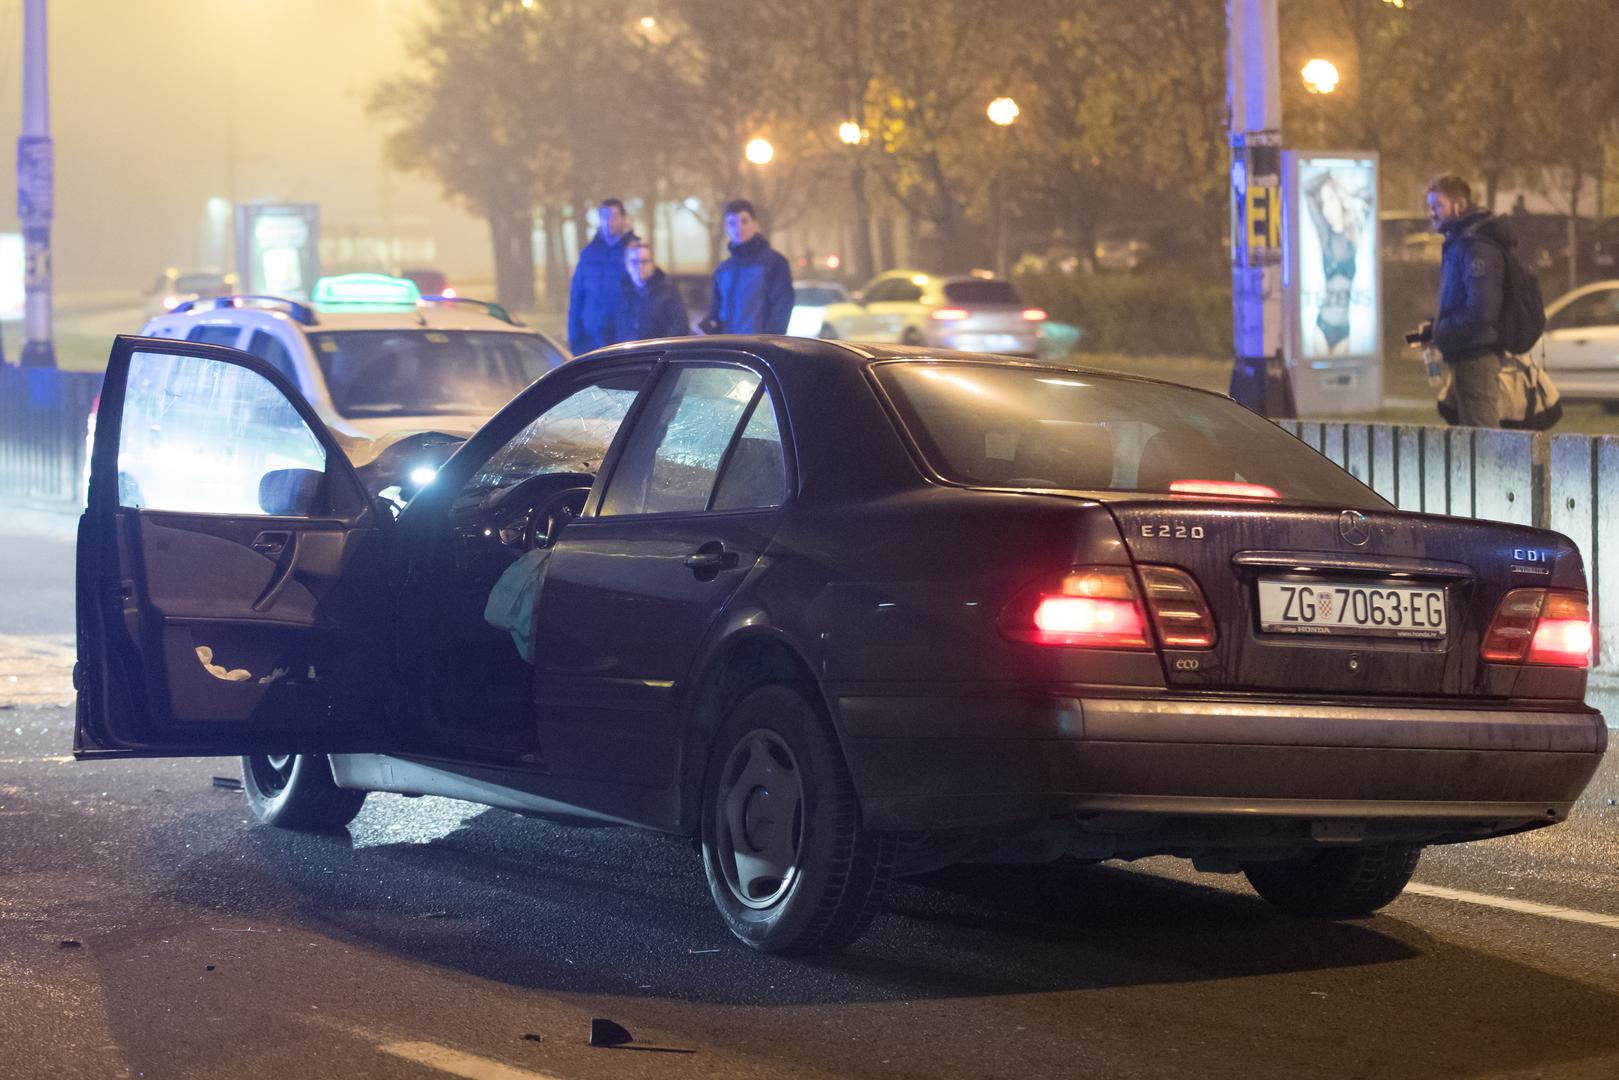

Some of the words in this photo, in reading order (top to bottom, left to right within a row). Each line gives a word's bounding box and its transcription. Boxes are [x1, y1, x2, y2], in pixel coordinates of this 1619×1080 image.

[1514, 549, 1546, 562] CDI
[1280, 586, 1316, 622] ZG
[1298, 626, 1331, 634] HONDA
